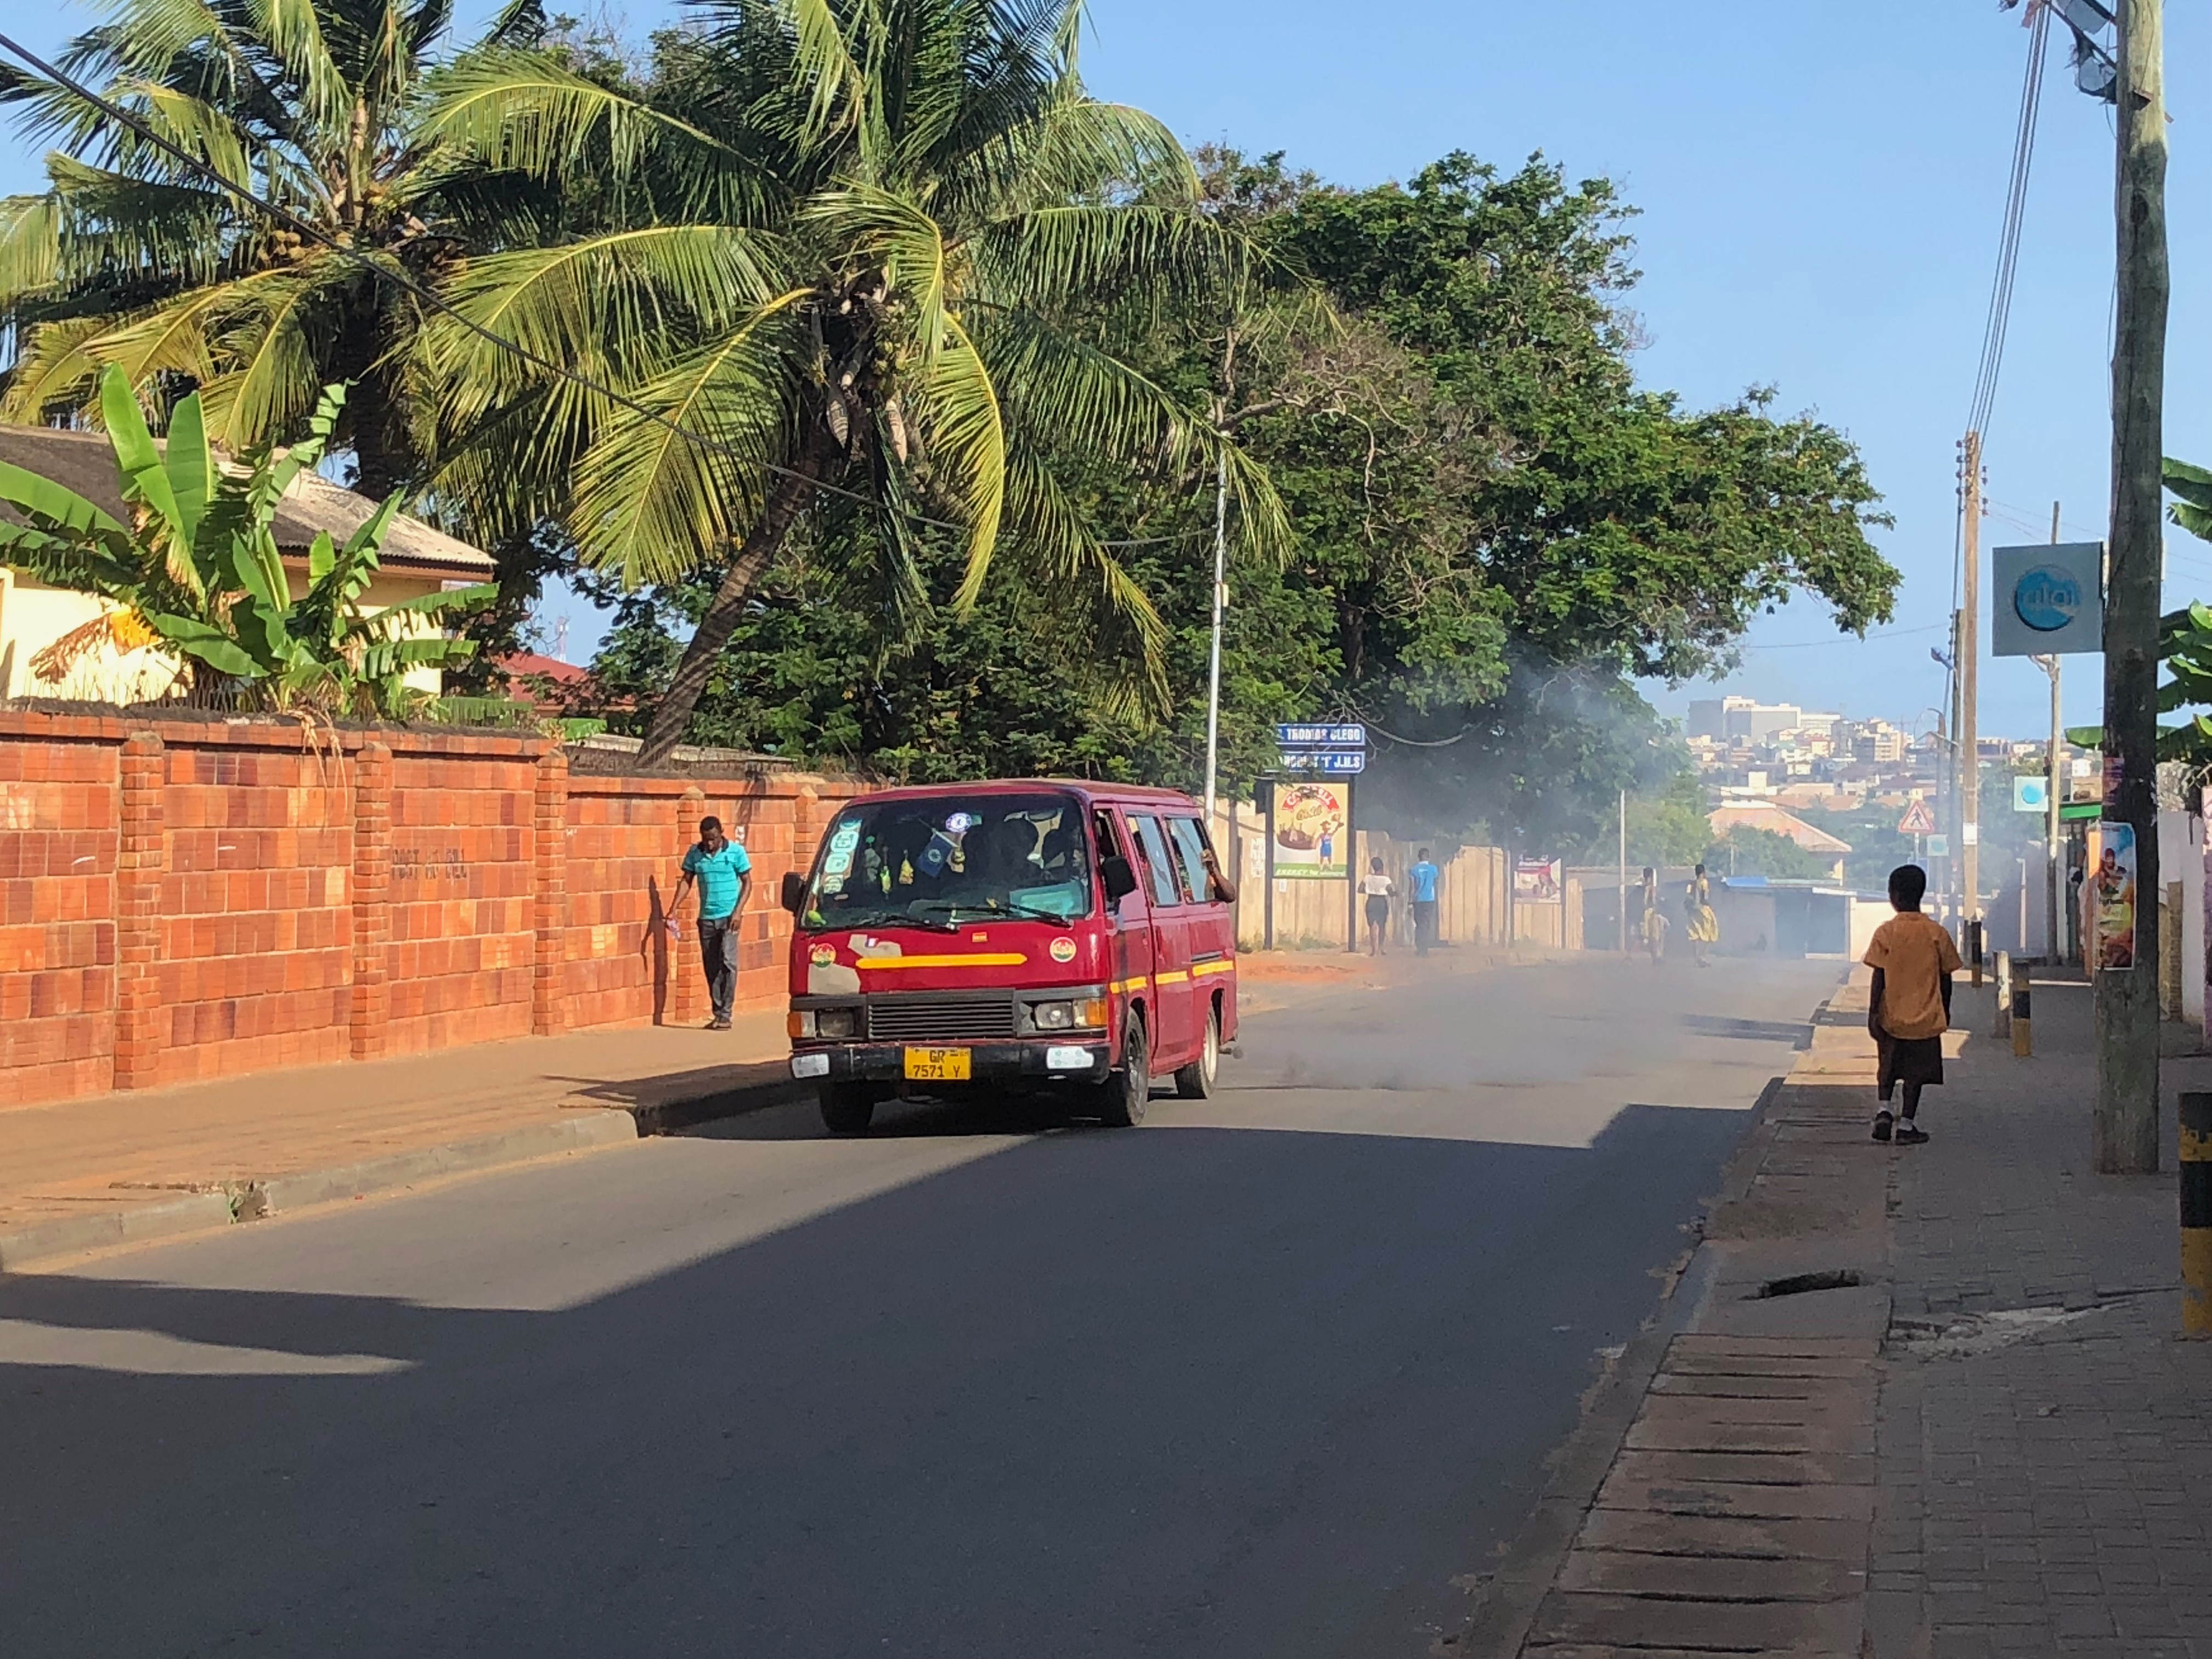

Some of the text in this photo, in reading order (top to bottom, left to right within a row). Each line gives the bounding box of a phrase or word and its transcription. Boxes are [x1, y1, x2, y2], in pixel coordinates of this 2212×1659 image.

[1286, 729, 1328, 741] THOMAS
[929, 1049, 945, 1064] GR
[913, 1065, 960, 1077] 7571 Y
